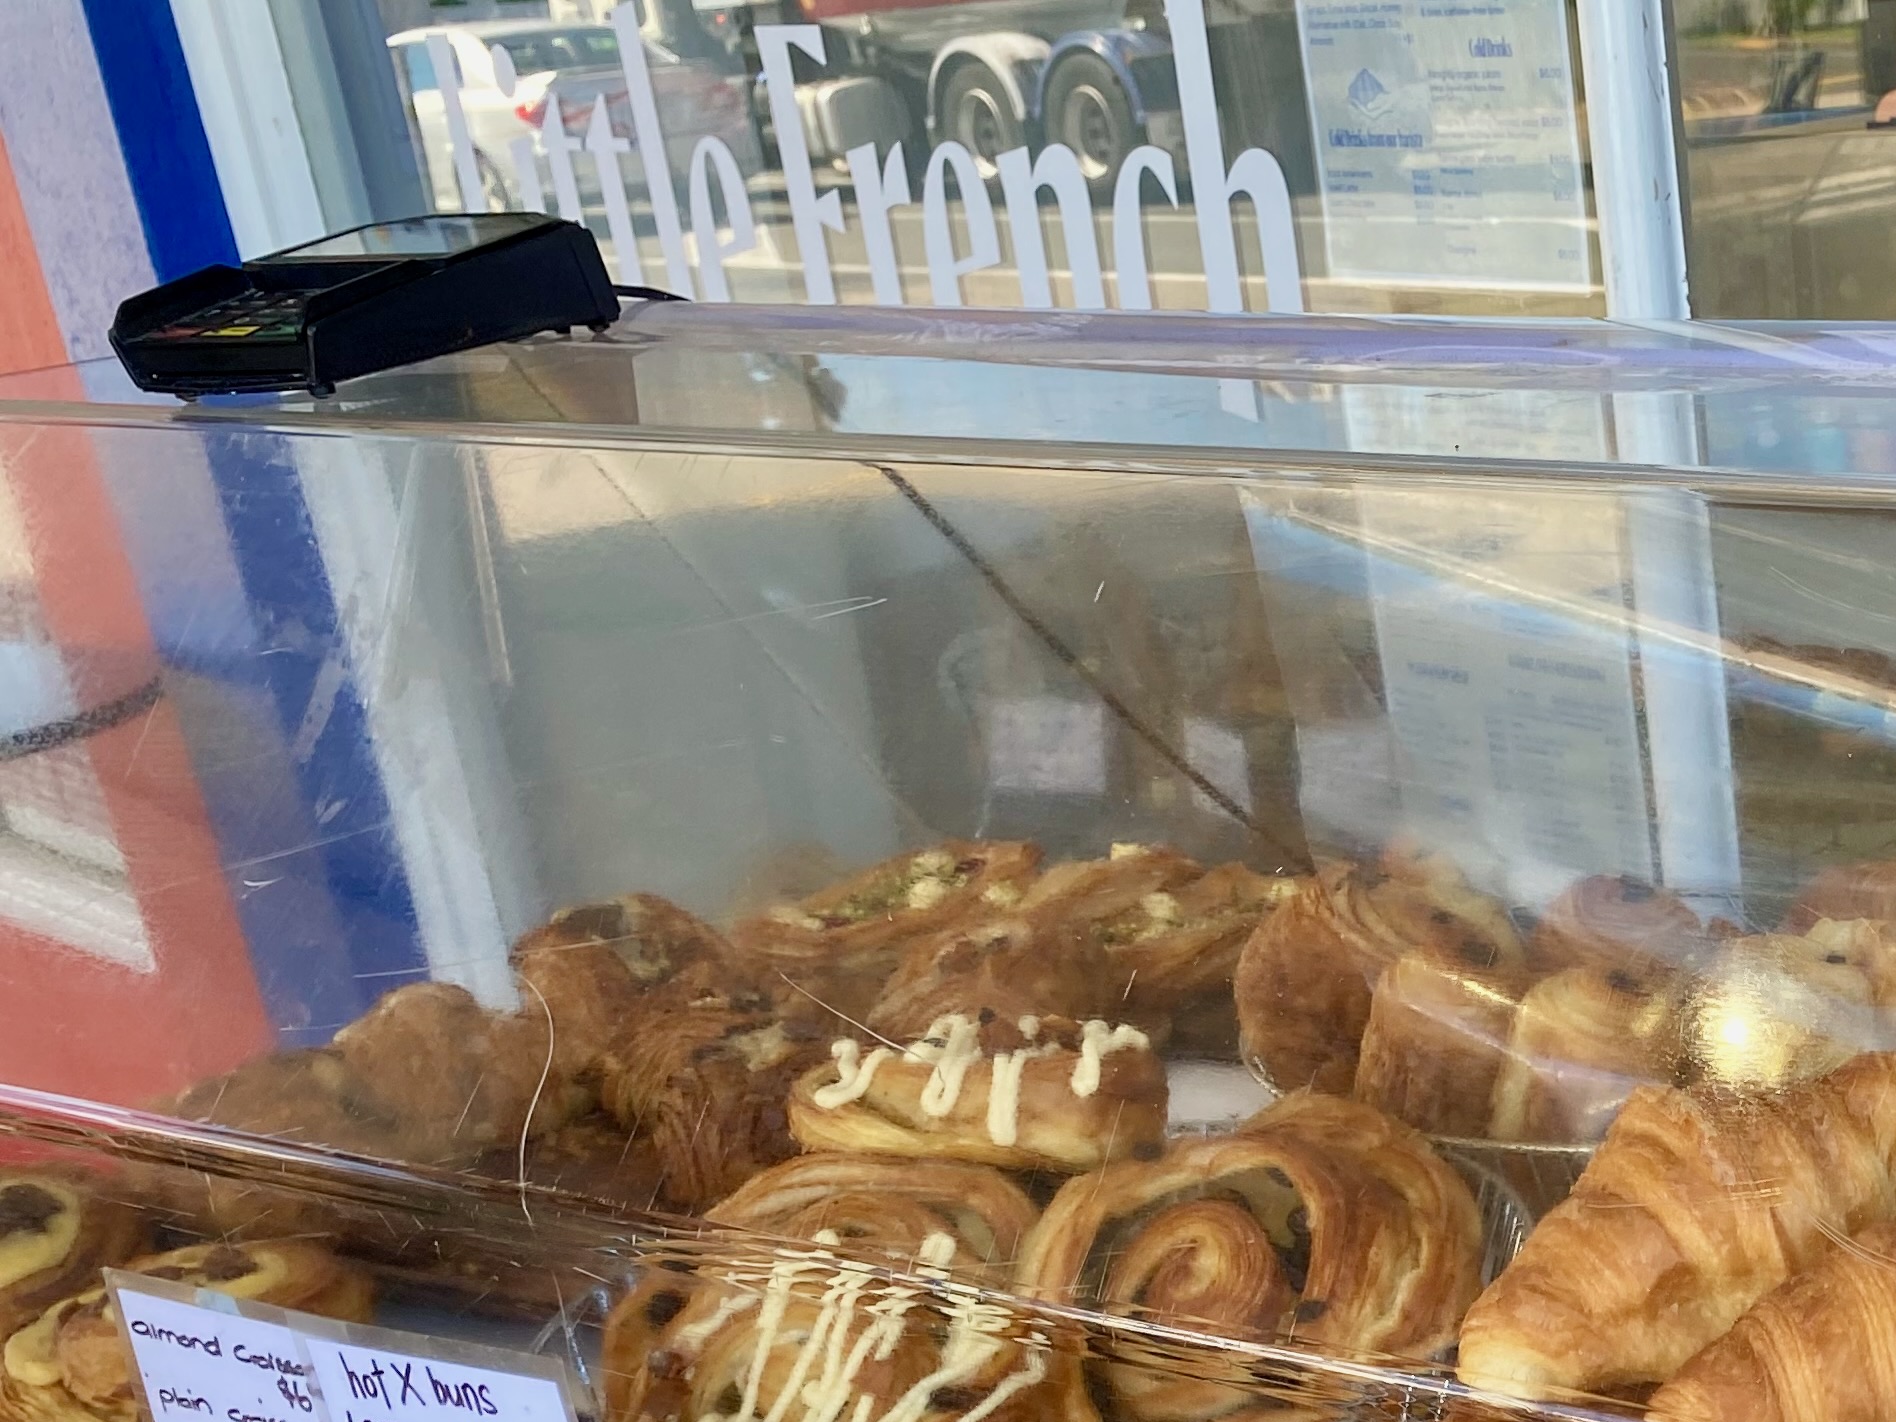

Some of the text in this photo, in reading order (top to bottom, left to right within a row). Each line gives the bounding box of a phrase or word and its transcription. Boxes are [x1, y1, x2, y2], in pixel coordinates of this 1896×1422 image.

[338, 1351, 498, 1416] hot X buns
